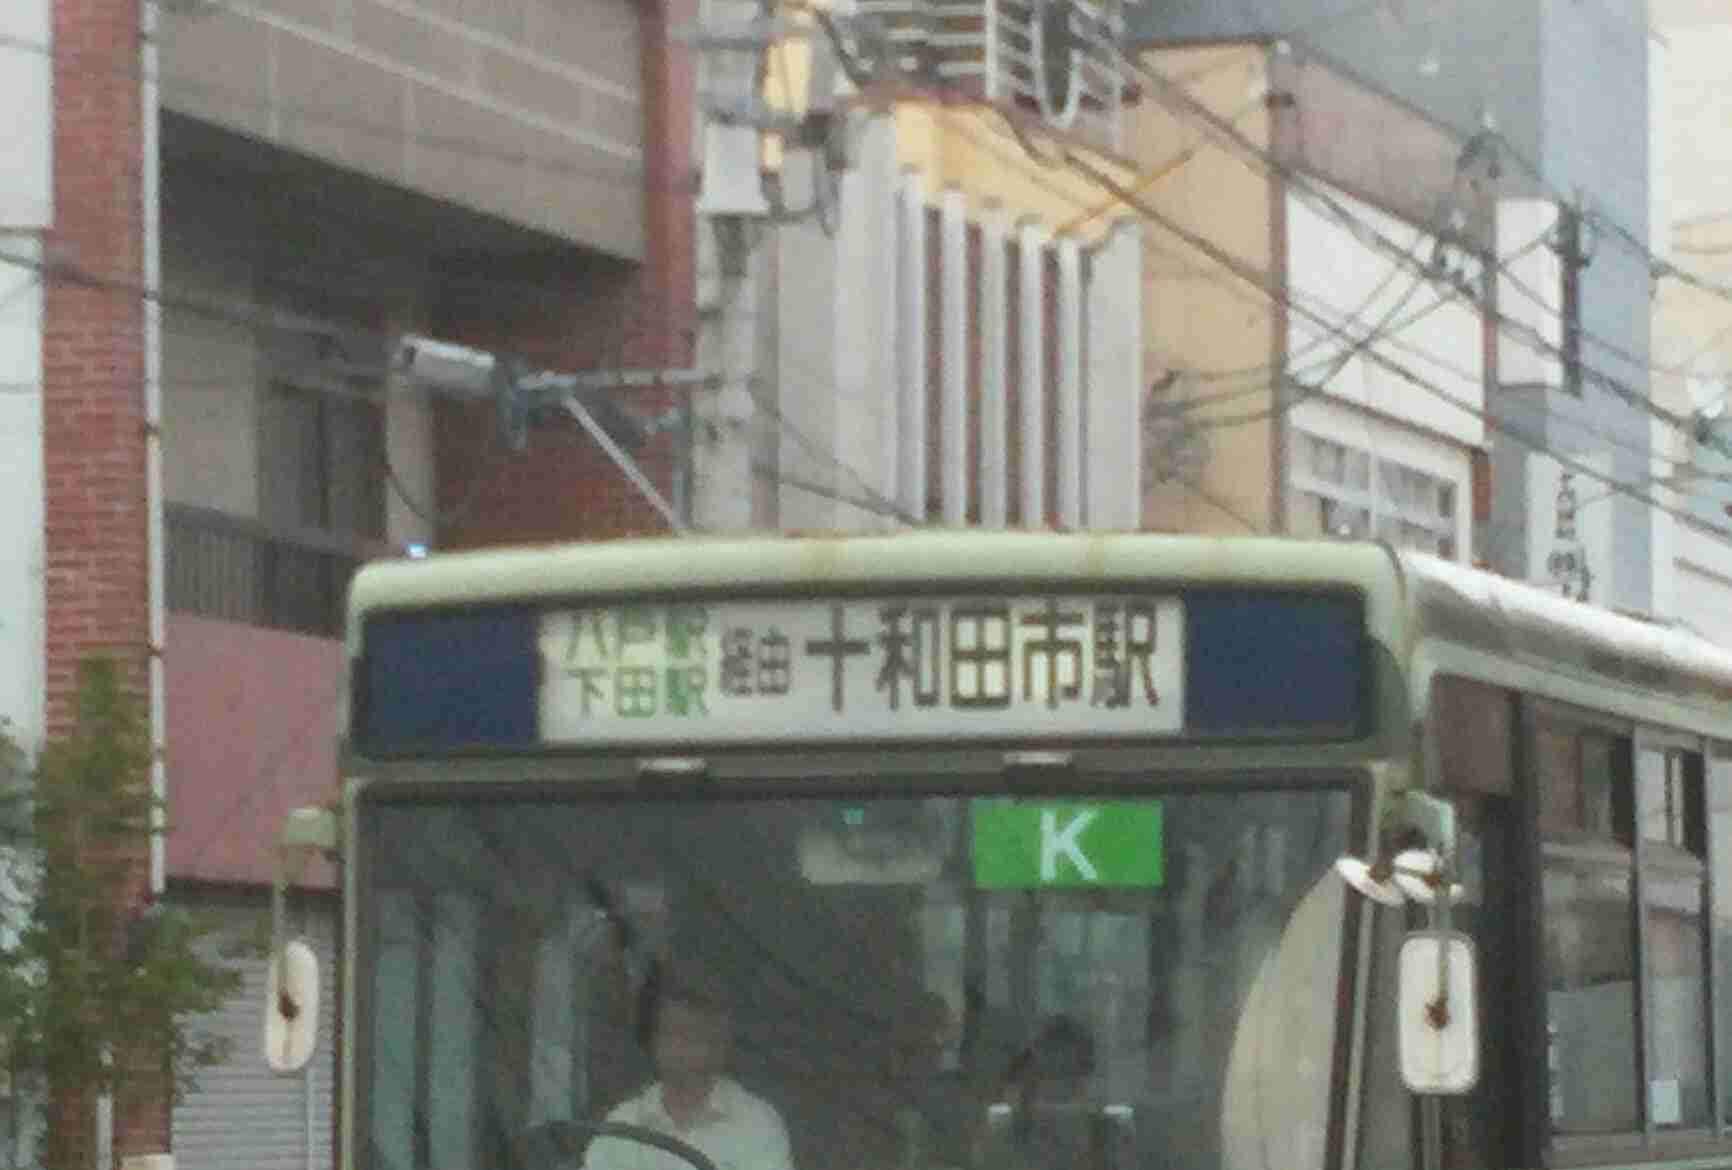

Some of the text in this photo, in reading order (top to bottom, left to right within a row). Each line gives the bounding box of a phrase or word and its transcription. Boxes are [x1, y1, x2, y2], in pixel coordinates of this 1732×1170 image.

[567, 666, 710, 720] 下田駅
[720, 626, 791, 698] 経由
[804, 602, 1160, 712] 十和田市駅
[1040, 808, 1098, 881] K
